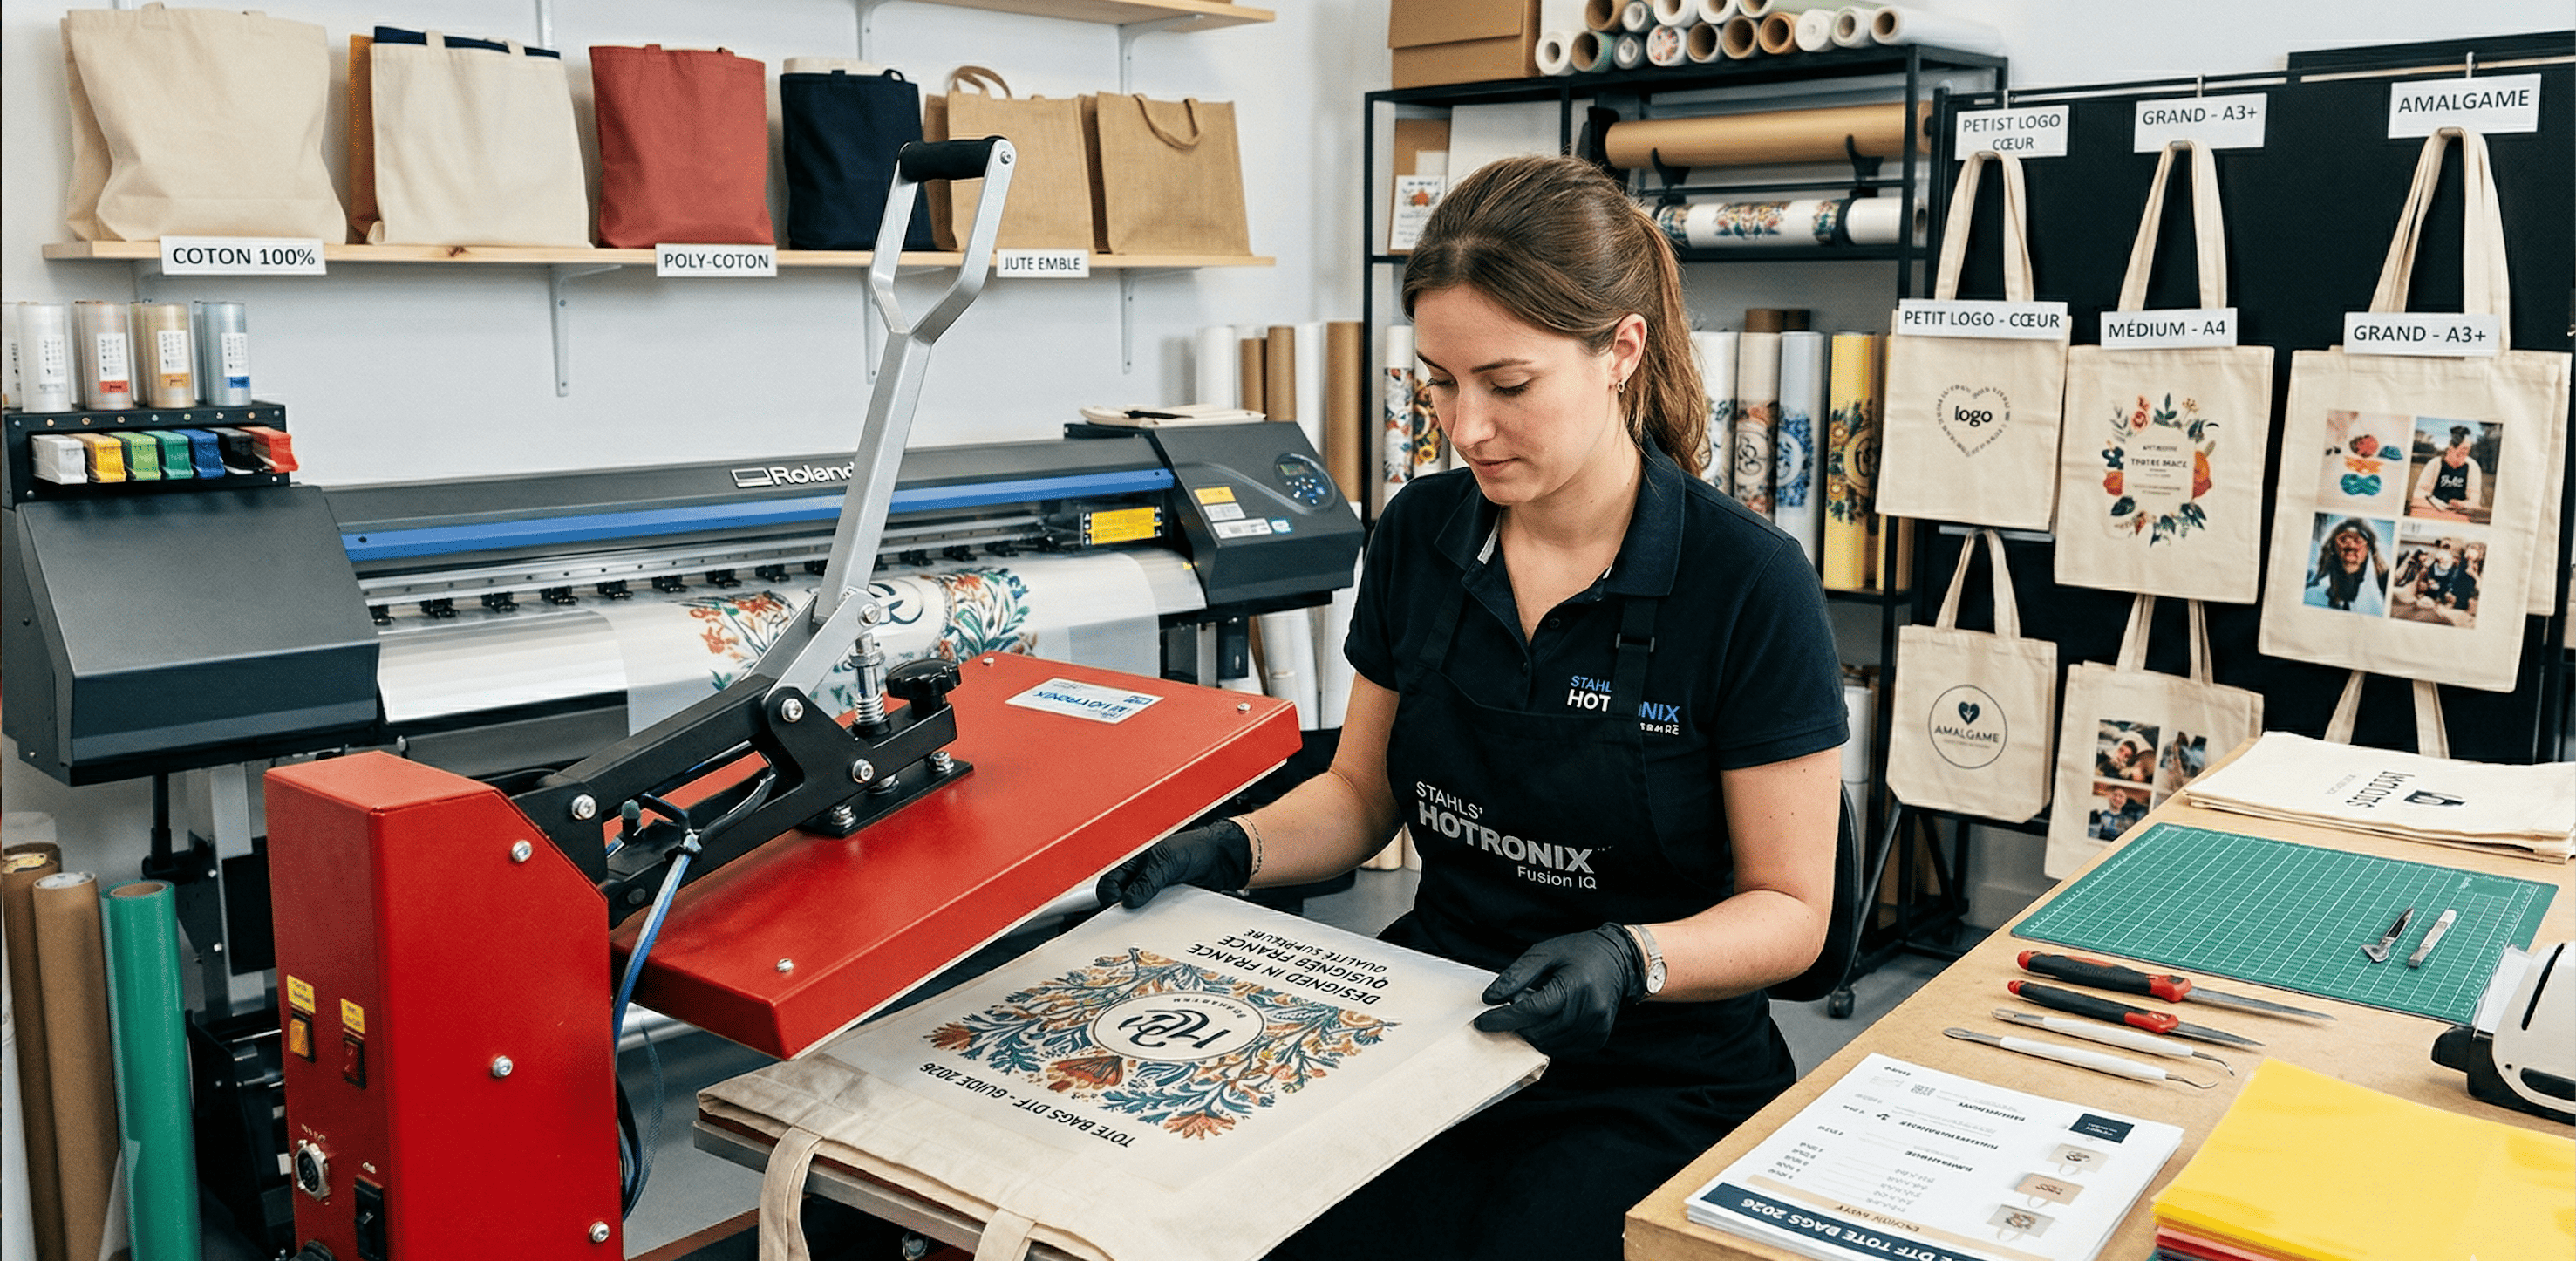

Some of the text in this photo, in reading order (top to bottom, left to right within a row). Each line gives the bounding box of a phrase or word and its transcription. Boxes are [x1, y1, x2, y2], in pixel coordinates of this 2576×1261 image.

[2398, 89, 2530, 113] AMALGAME
[2019, 114, 2061, 129] LOGO
[2142, 108, 2206, 126] GRAND
[2222, 105, 2258, 121] A3+
[1992, 137, 2034, 151] CŒUR
[173, 248, 316, 266] COTON 100%
[664, 253, 768, 269] POLY-COTON
[1004, 257, 1080, 270] JUTE EMBLE
[1904, 310, 1946, 325] PETIT
[1951, 311, 1994, 326] LOGO
[2009, 312, 2060, 328] CŒUR
[2109, 319, 2185, 337] MÉDIUM
[2203, 320, 2226, 336] A4
[2354, 324, 2426, 342] GRAND
[2445, 326, 2486, 343] A3+
[1954, 406, 1993, 427] logo
[1571, 675, 1612, 692] STAHL
[1934, 725, 1999, 743] AMALGAME
[1418, 800, 1595, 874] HOTRONIX
[1517, 866, 1597, 890] Fusion IQ
[1217, 935, 1296, 963] FRANCE
[1186, 944, 1381, 1005] DESIGNED IN FRANCE
[919, 1062, 963, 1082] 2026
[956, 1075, 1008, 1100] GUIDE
[1012, 1098, 1051, 1114] DTF
[1046, 1109, 1096, 1132] BAGS
[1091, 1125, 1135, 1148] TOTE
[1740, 1197, 1788, 1220] 2026
[1788, 1213, 1838, 1237] BAGS
[1841, 1230, 1891, 1252] TOTE
[1894, 1245, 1936, 1261] DTF
